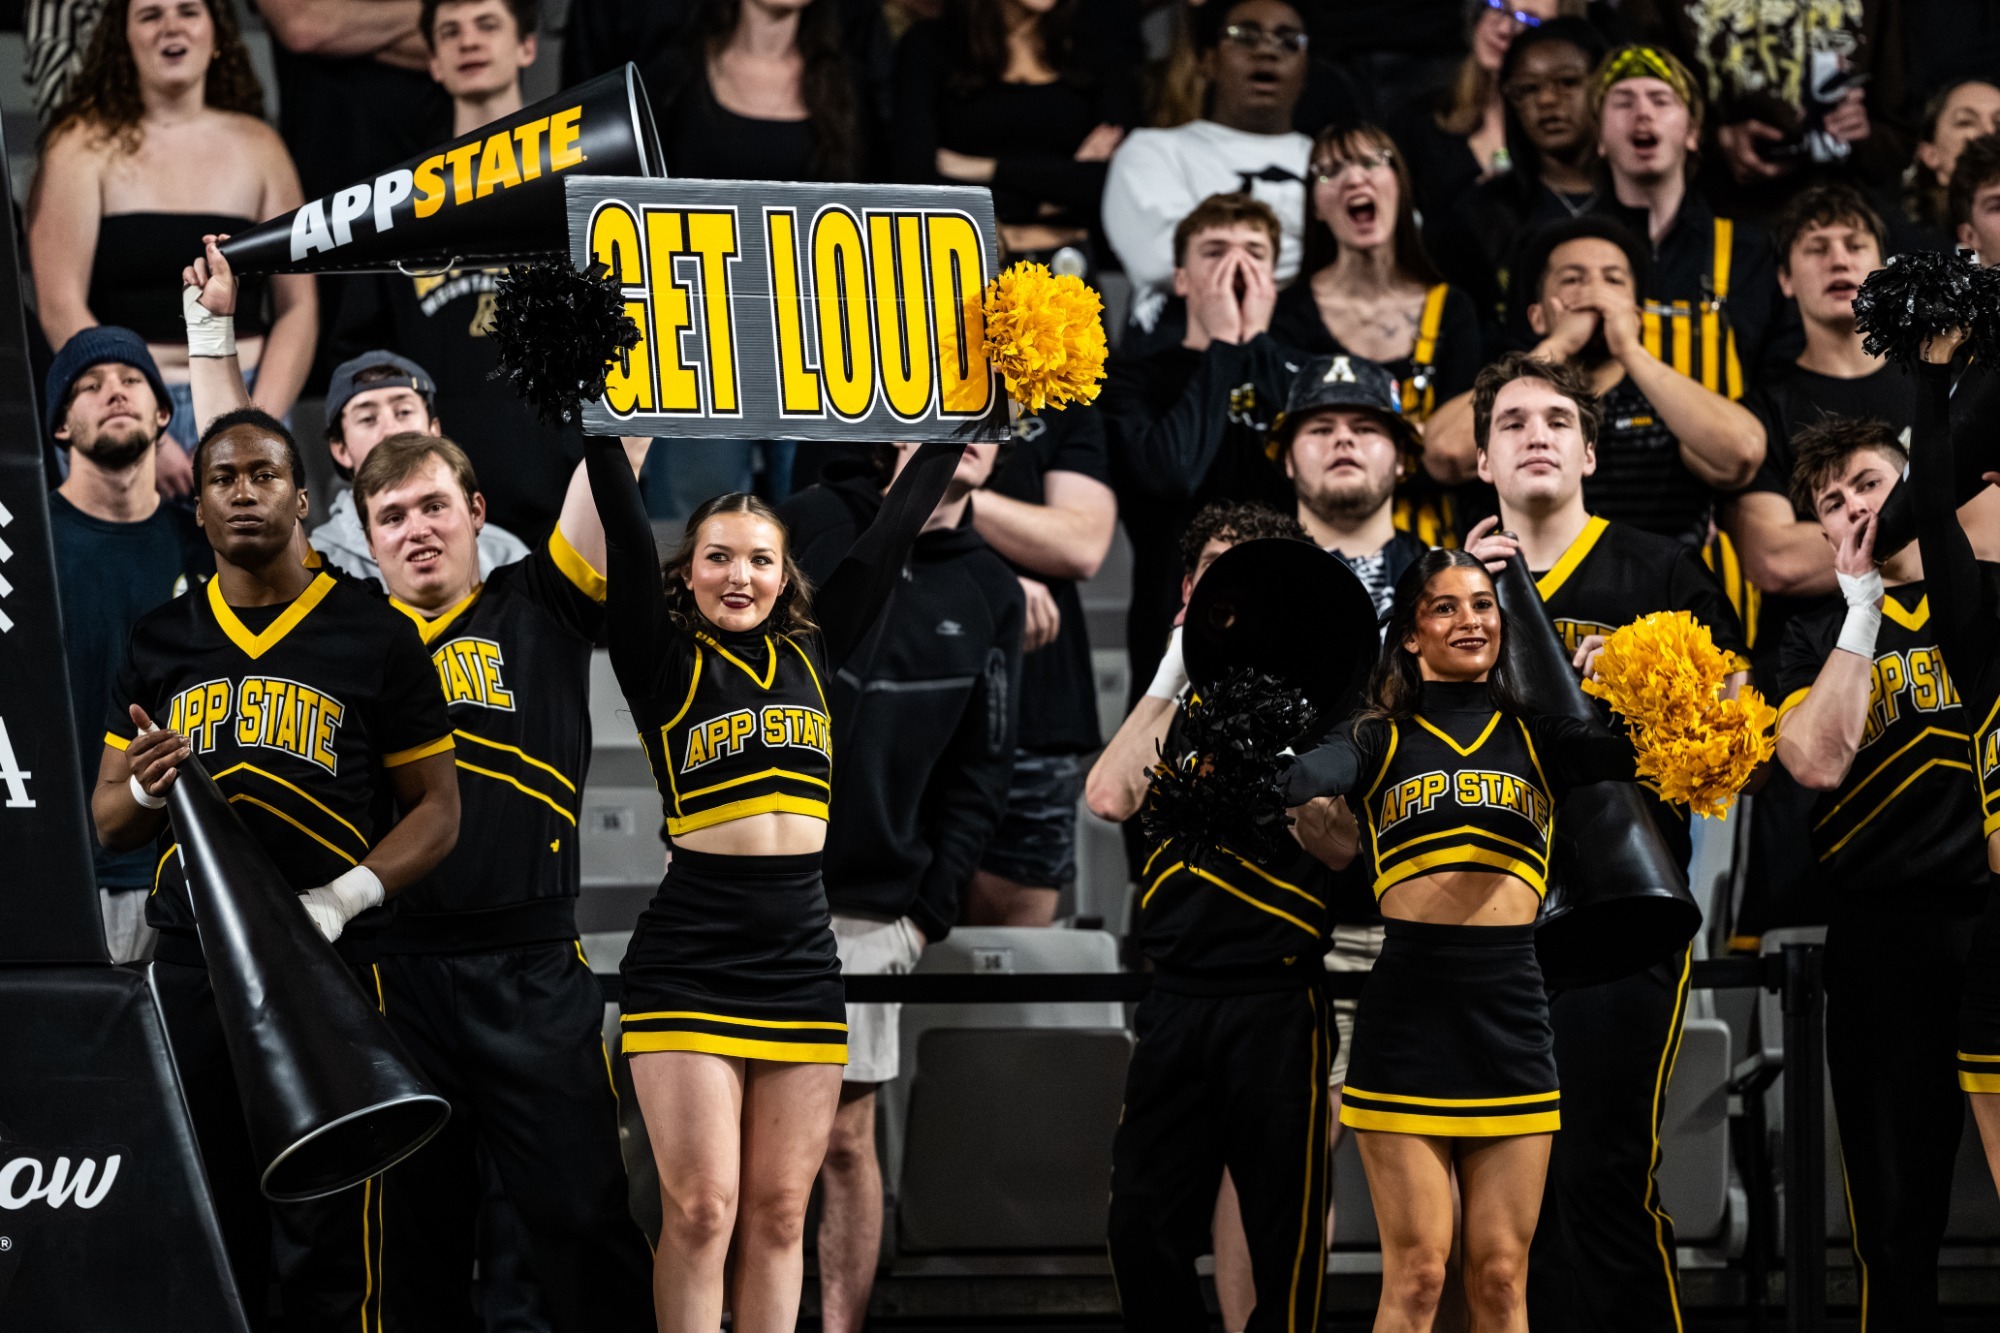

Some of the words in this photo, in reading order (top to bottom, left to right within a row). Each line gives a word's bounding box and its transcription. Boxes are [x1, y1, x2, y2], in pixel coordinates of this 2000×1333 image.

[585, 198, 743, 421] GET
[762, 203, 997, 424] LOUD
[1323, 356, 1356, 384] A
[431, 636, 516, 712] TATE
[235, 675, 346, 777] STATE
[680, 707, 757, 775] APP
[1377, 769, 1450, 838] APP
[1453, 769, 1548, 842] STATE
